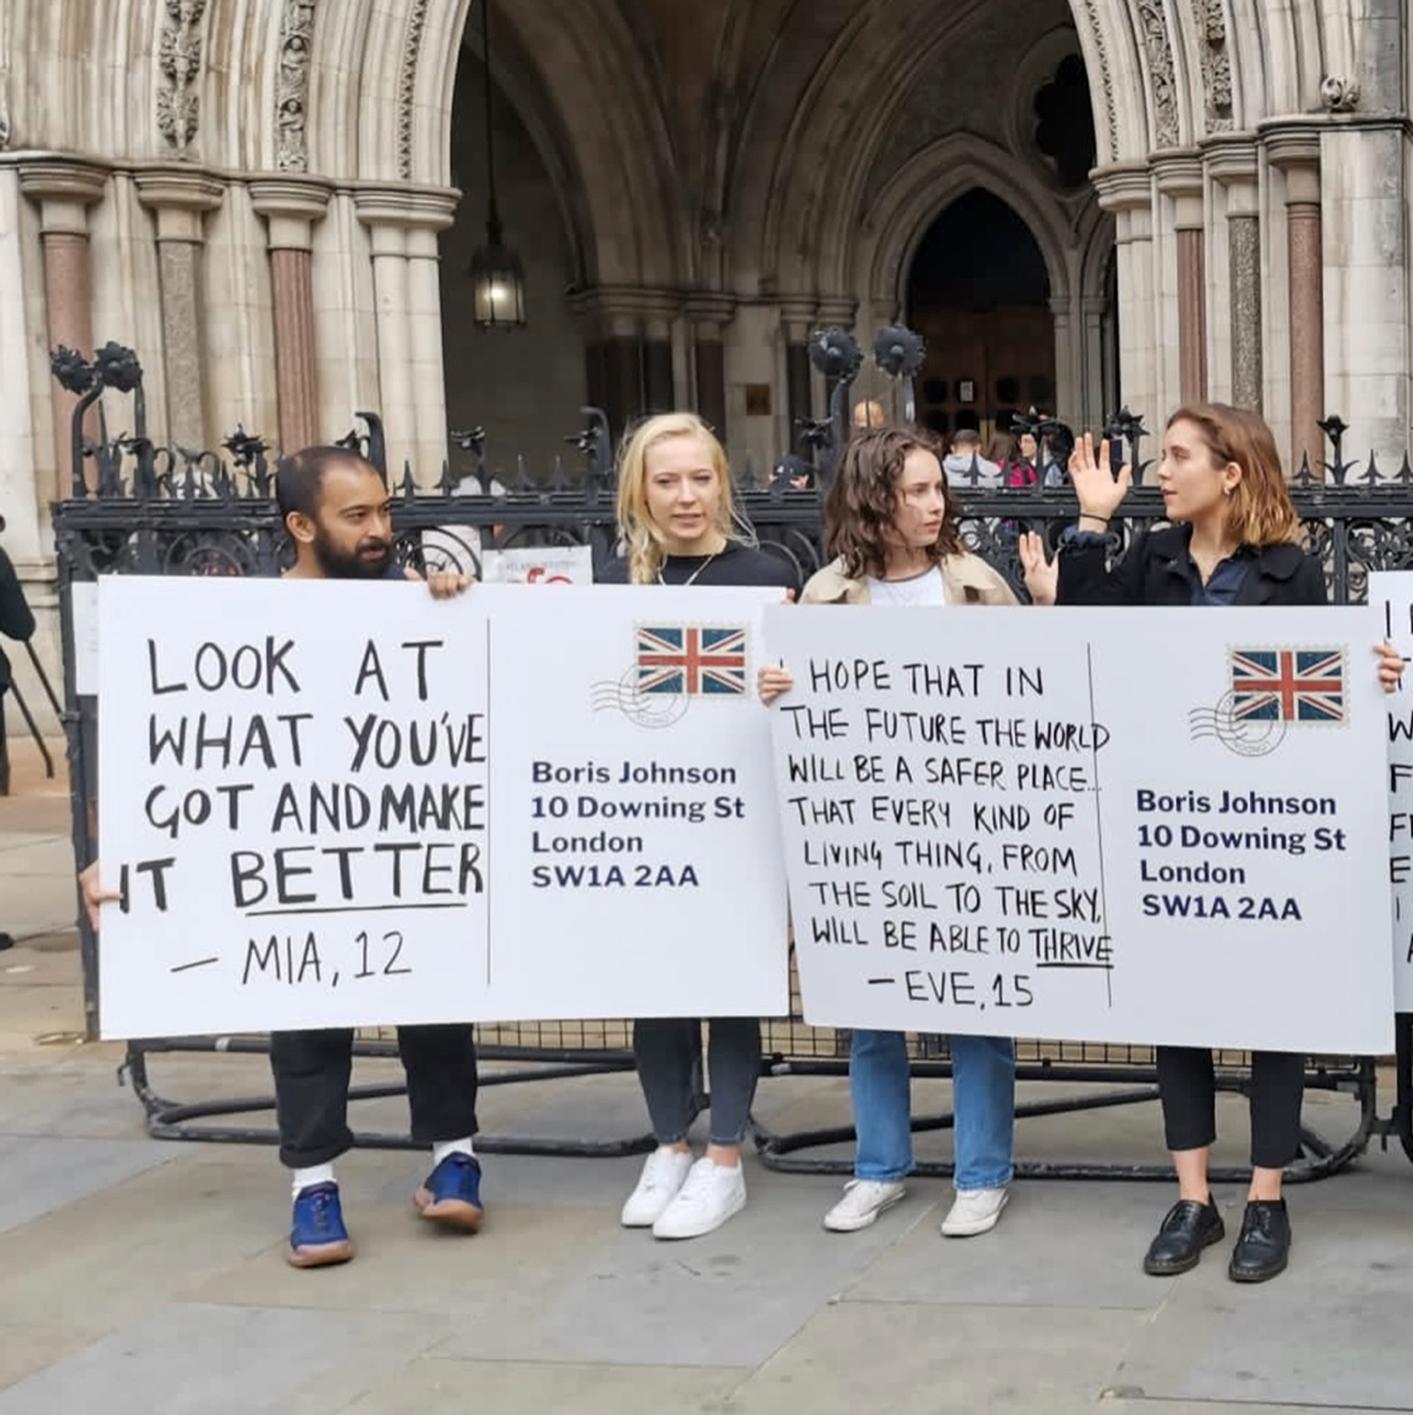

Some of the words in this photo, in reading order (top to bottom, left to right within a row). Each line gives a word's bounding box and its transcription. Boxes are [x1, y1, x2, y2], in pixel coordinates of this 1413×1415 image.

[1384, 599, 1392, 639] I
[147, 635, 301, 696] LOOK
[354, 638, 444, 702] AT
[809, 658, 892, 694] HOPE
[902, 662, 985, 698] THAT
[1006, 666, 1044, 697] IN
[148, 711, 314, 771] WHAT
[343, 710, 487, 774] YOU'VE
[779, 704, 850, 741] THE
[864, 707, 967, 746] FUTURE
[975, 717, 1027, 749] THE
[1034, 717, 1111, 755] WORLD
[532, 760, 611, 784] Boris
[618, 760, 737, 785] Johnson
[787, 753, 845, 784] WILL
[853, 754, 886, 784] BE
[895, 755, 914, 784] A
[924, 756, 1006, 792] SAFER
[144, 783, 255, 838] GOT
[270, 781, 372, 835] AND
[378, 782, 486, 834] MAKE
[531, 795, 569, 819] 10
[577, 795, 707, 824] Downing
[713, 795, 746, 819] St
[787, 796, 856, 827] THAT
[871, 795, 951, 829] EVERY
[973, 801, 1031, 835] KIND
[1043, 802, 1075, 832] OF
[1136, 788, 1212, 814] Boris
[1218, 789, 1337, 816] Johnson
[532, 830, 643, 854] London
[803, 839, 883, 871] LIVING
[894, 839, 993, 875] THING,
[1001, 843, 1078, 878] FROM
[1137, 824, 1174, 848] 10
[1180, 824, 1307, 856] Downing
[1313, 826, 1347, 852] St
[117, 856, 177, 915] IT
[230, 841, 484, 908] BETTER
[532, 864, 626, 889] SW1A
[633, 864, 700, 887] 2AA
[1140, 858, 1246, 885] London
[808, 880, 871, 908] THE
[881, 880, 939, 910] SOIL
[944, 881, 982, 914] TO
[994, 885, 1049, 920] THE
[1053, 886, 1102, 924] SKY,
[1142, 893, 1231, 919] SW1A
[1237, 896, 1303, 922] 2AA
[1395, 896, 1401, 921] I
[811, 915, 869, 946] WILL
[882, 919, 917, 952] BE
[929, 921, 990, 955] ABLE
[995, 926, 1021, 954] TO
[1032, 924, 1114, 965] THRIVE
